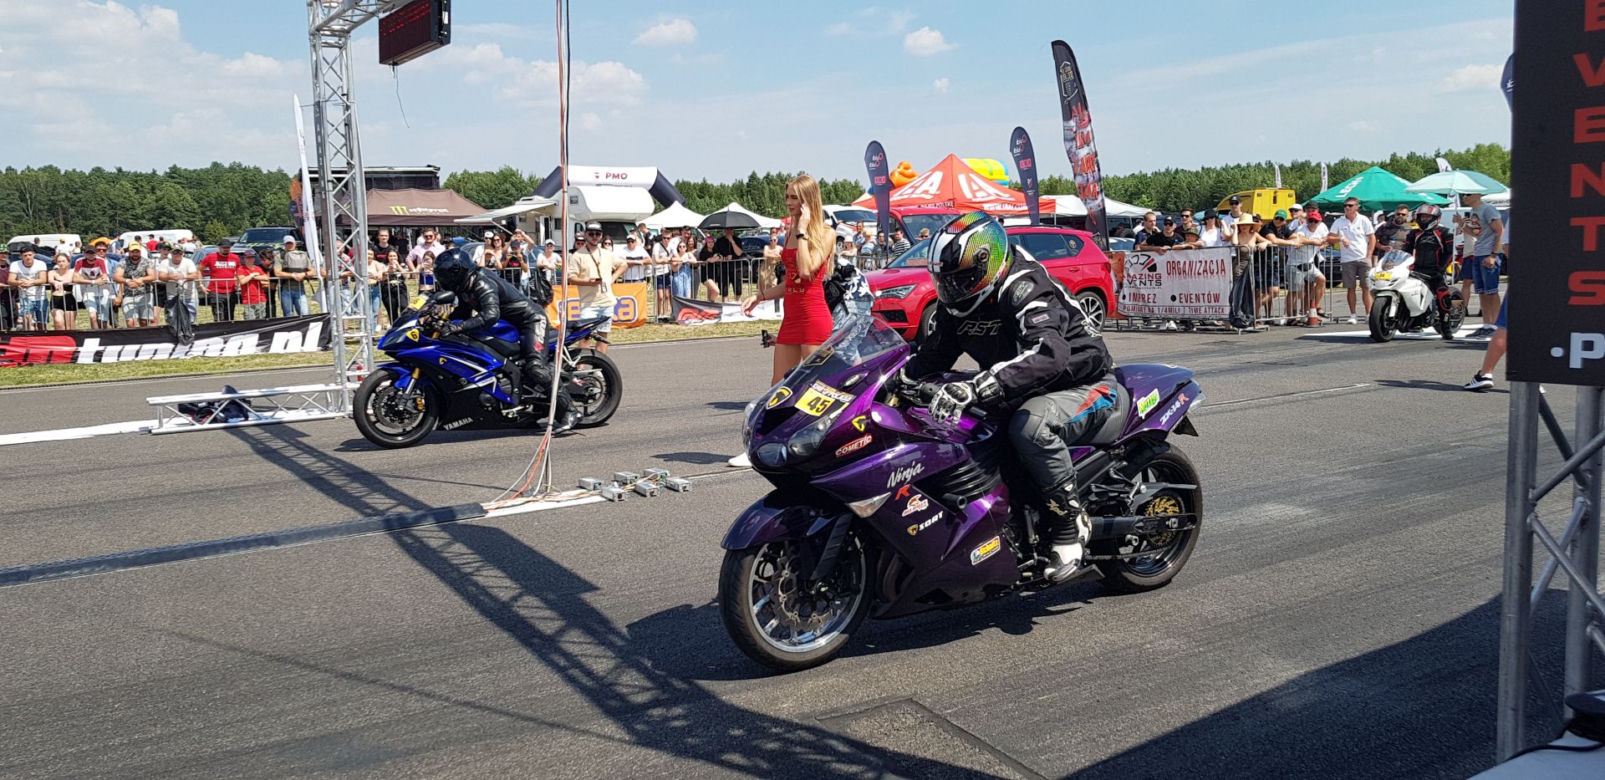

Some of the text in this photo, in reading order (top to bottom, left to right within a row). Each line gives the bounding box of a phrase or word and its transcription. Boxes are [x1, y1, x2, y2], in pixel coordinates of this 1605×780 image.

[605, 172, 628, 180] PMO
[1166, 259, 1226, 276] ORGANIZACJA
[1178, 291, 1220, 304] EVENTÓW
[957, 320, 1003, 336] RST
[806, 396, 831, 413] 45
[443, 417, 473, 431] YAMAHA
[835, 434, 872, 457] COMETIC
[887, 461, 925, 488] Ninja
[896, 484, 911, 500] R
